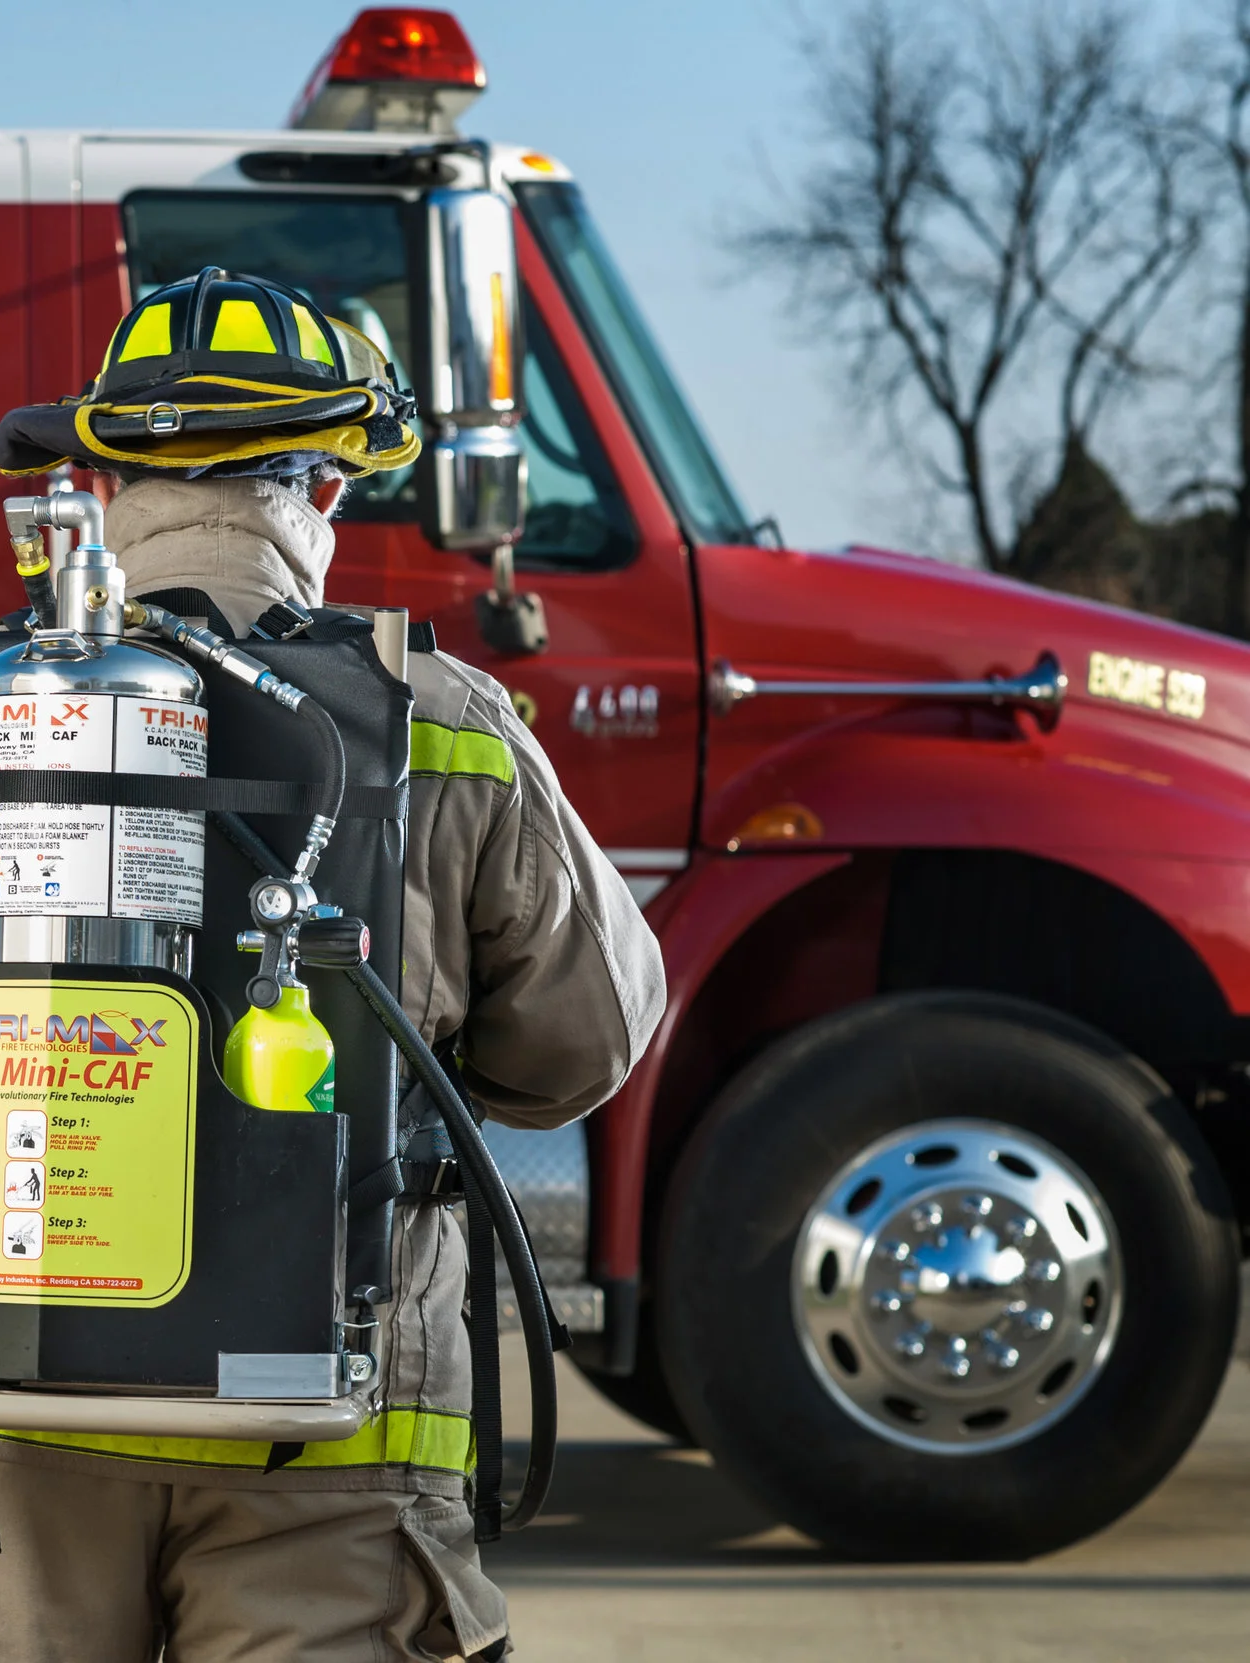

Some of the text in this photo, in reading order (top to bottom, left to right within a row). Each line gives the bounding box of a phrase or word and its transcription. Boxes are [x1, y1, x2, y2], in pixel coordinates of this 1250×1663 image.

[1088, 651, 1165, 709] ENGINE
[147, 735, 176, 748] BACK
[179, 739, 198, 752] PACK
[1, 1043, 18, 1051] FIRE
[20, 1043, 87, 1053] TECHNOLOGIES
[1, 1057, 153, 1090] Mini-CAF
[49, 1091, 68, 1102] Fire
[70, 1092, 135, 1104] Technologies
[51, 1116, 90, 1129] Step 1:
[50, 1167, 88, 1180] Step 2:
[48, 1217, 87, 1229] Step 3:
[36, 1277, 47, 1285] Inc.
[50, 1278, 78, 1287] Redding
